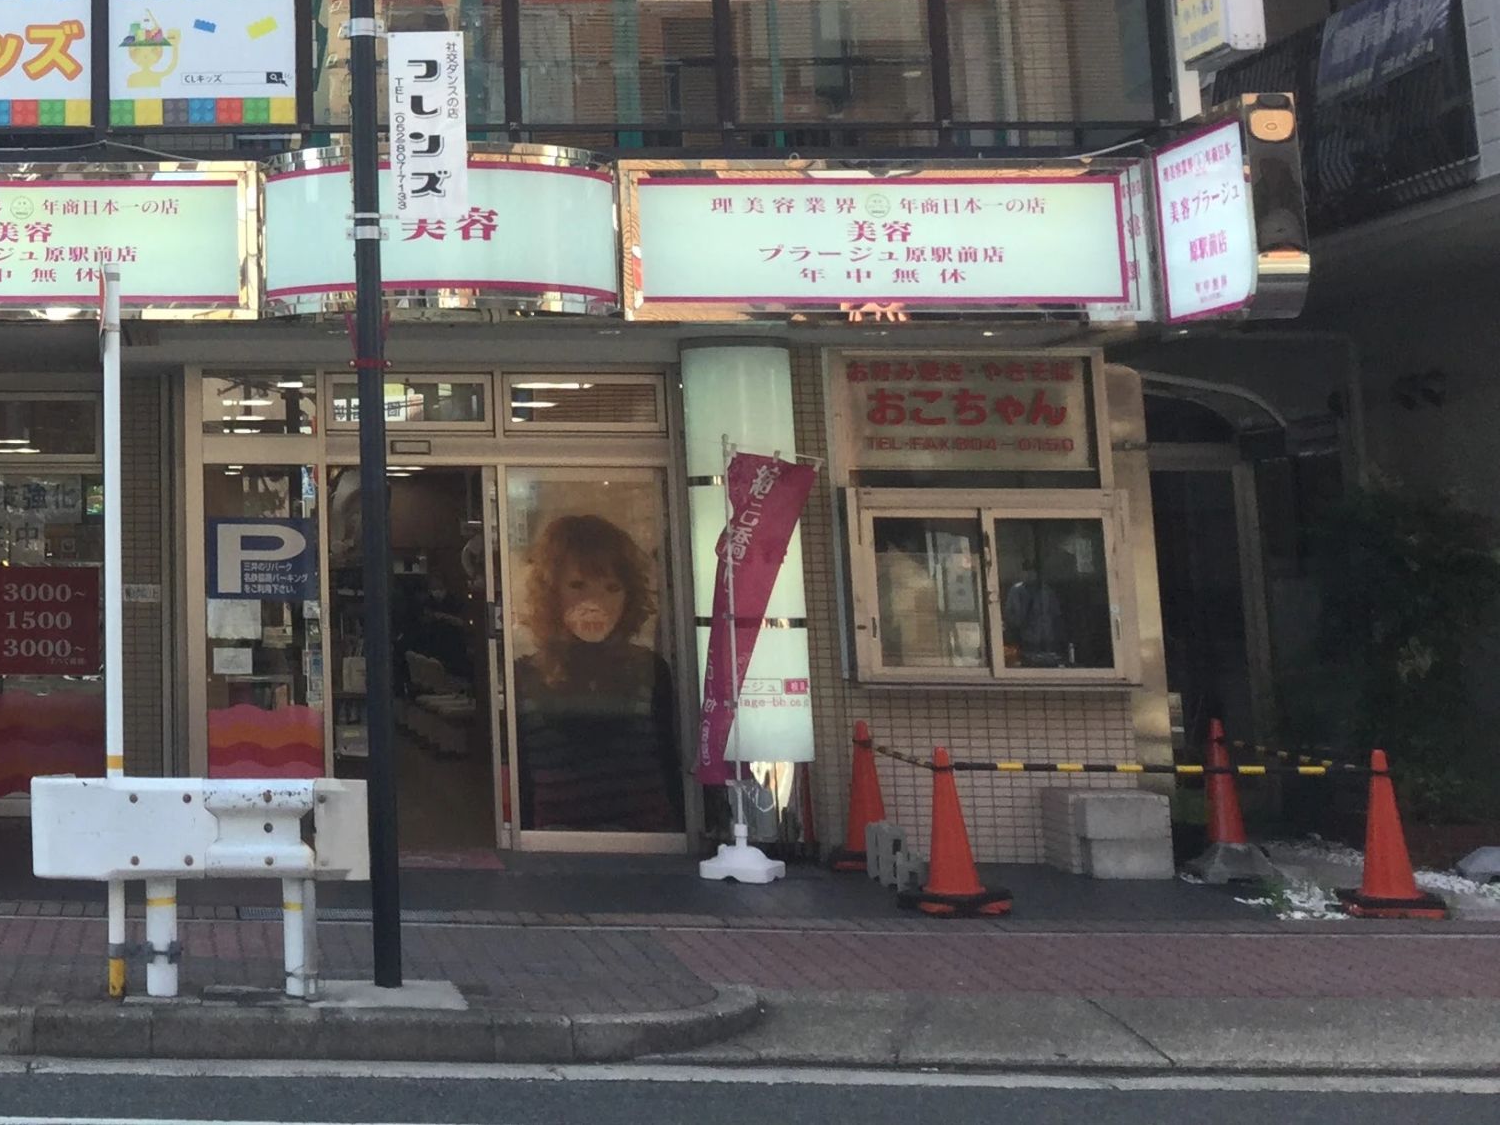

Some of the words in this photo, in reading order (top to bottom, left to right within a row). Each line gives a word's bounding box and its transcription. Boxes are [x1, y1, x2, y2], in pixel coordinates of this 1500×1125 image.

[446, 42, 459, 120] 社交ダンスの店
[406, 60, 451, 198] フレンズ
[41, 197, 180, 216] 年商日本一の店
[710, 196, 859, 215] 理美容業界
[899, 196, 1048, 215] 年商日本一の店
[846, 220, 913, 243] 美容
[758, 244, 1005, 264] プラージュ原駅前店
[798, 267, 968, 284] 年中無休
[867, 388, 1068, 426] おこちゃん
[217, 523, 307, 594] P
[5, 611, 73, 630] 1500
